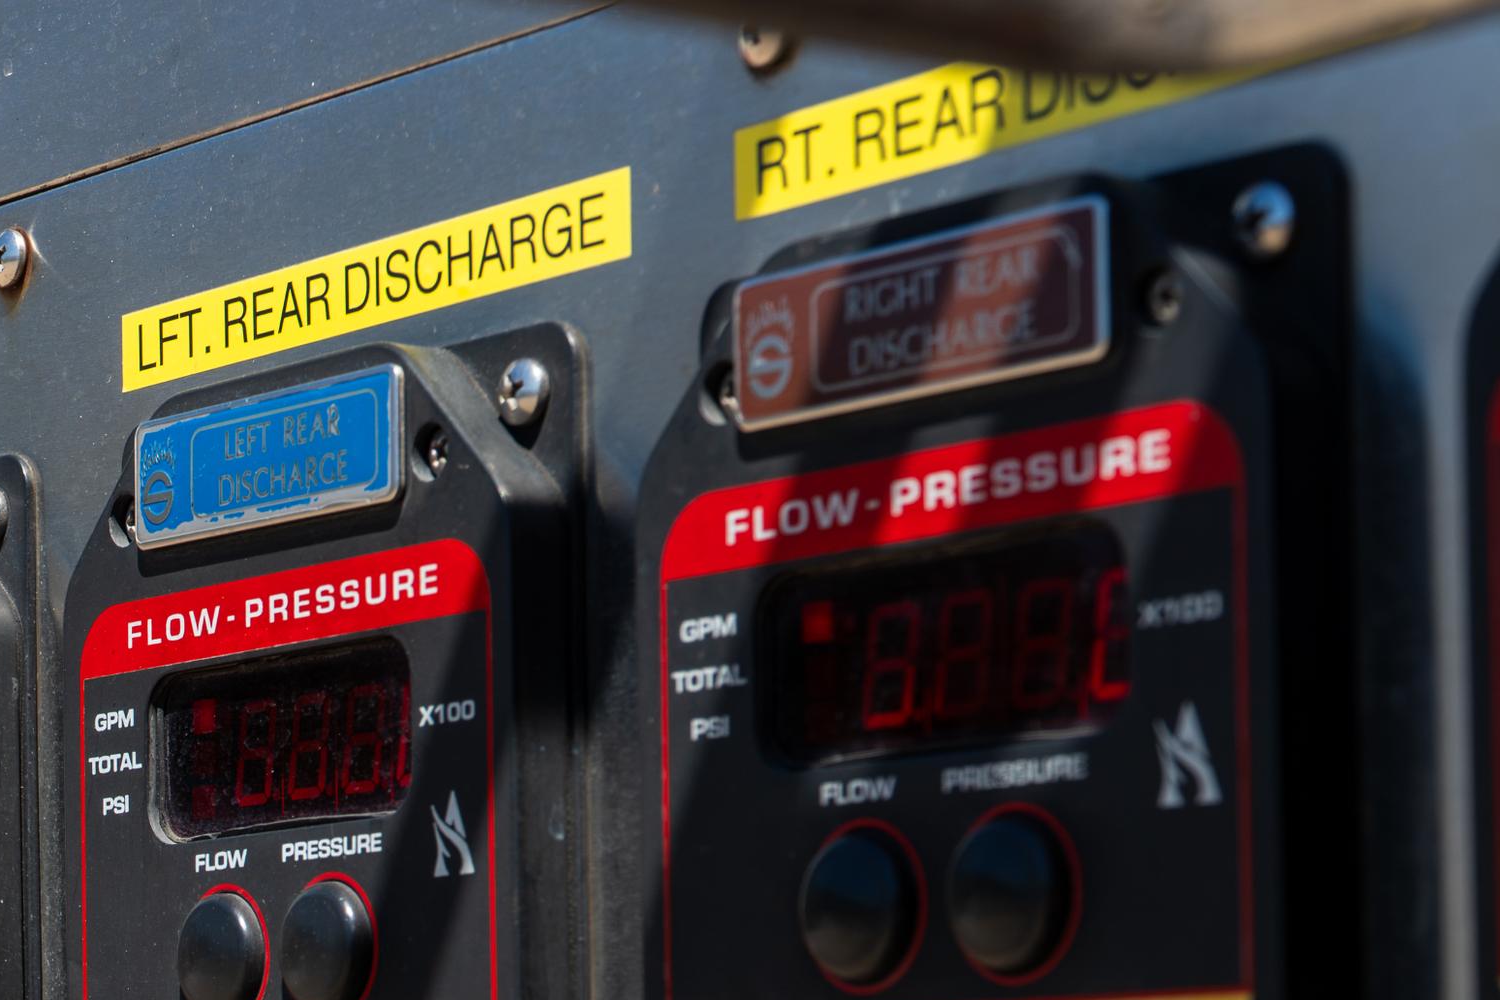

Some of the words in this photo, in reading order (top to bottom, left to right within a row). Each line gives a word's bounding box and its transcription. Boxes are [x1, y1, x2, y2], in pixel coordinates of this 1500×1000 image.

[756, 124, 836, 196] RT.
[853, 68, 1006, 170] REAR
[137, 306, 212, 372] LFT.
[223, 272, 331, 349] REAR
[344, 192, 606, 315] DISCHARGE
[845, 266, 941, 322] RIGHT
[954, 246, 1040, 296] REAR
[849, 302, 1039, 377] DISCHARGE
[224, 421, 271, 462] LEFT
[284, 402, 342, 447] REAR
[218, 449, 349, 508] DISCHARGE
[1137, 591, 1224, 628] X100
[680, 614, 737, 643] GPM
[671, 664, 748, 694] TOTAL
[94, 709, 136, 732] GPM
[418, 700, 476, 728] X100
[690, 717, 730, 741] PSI
[88, 751, 143, 776] TOTAL
[941, 752, 1090, 794] PRESSURE
[102, 795, 131, 816] PSI
[819, 775, 897, 806] FLOW
[194, 849, 248, 873] FLOW
[281, 832, 384, 863] PRESSURE
